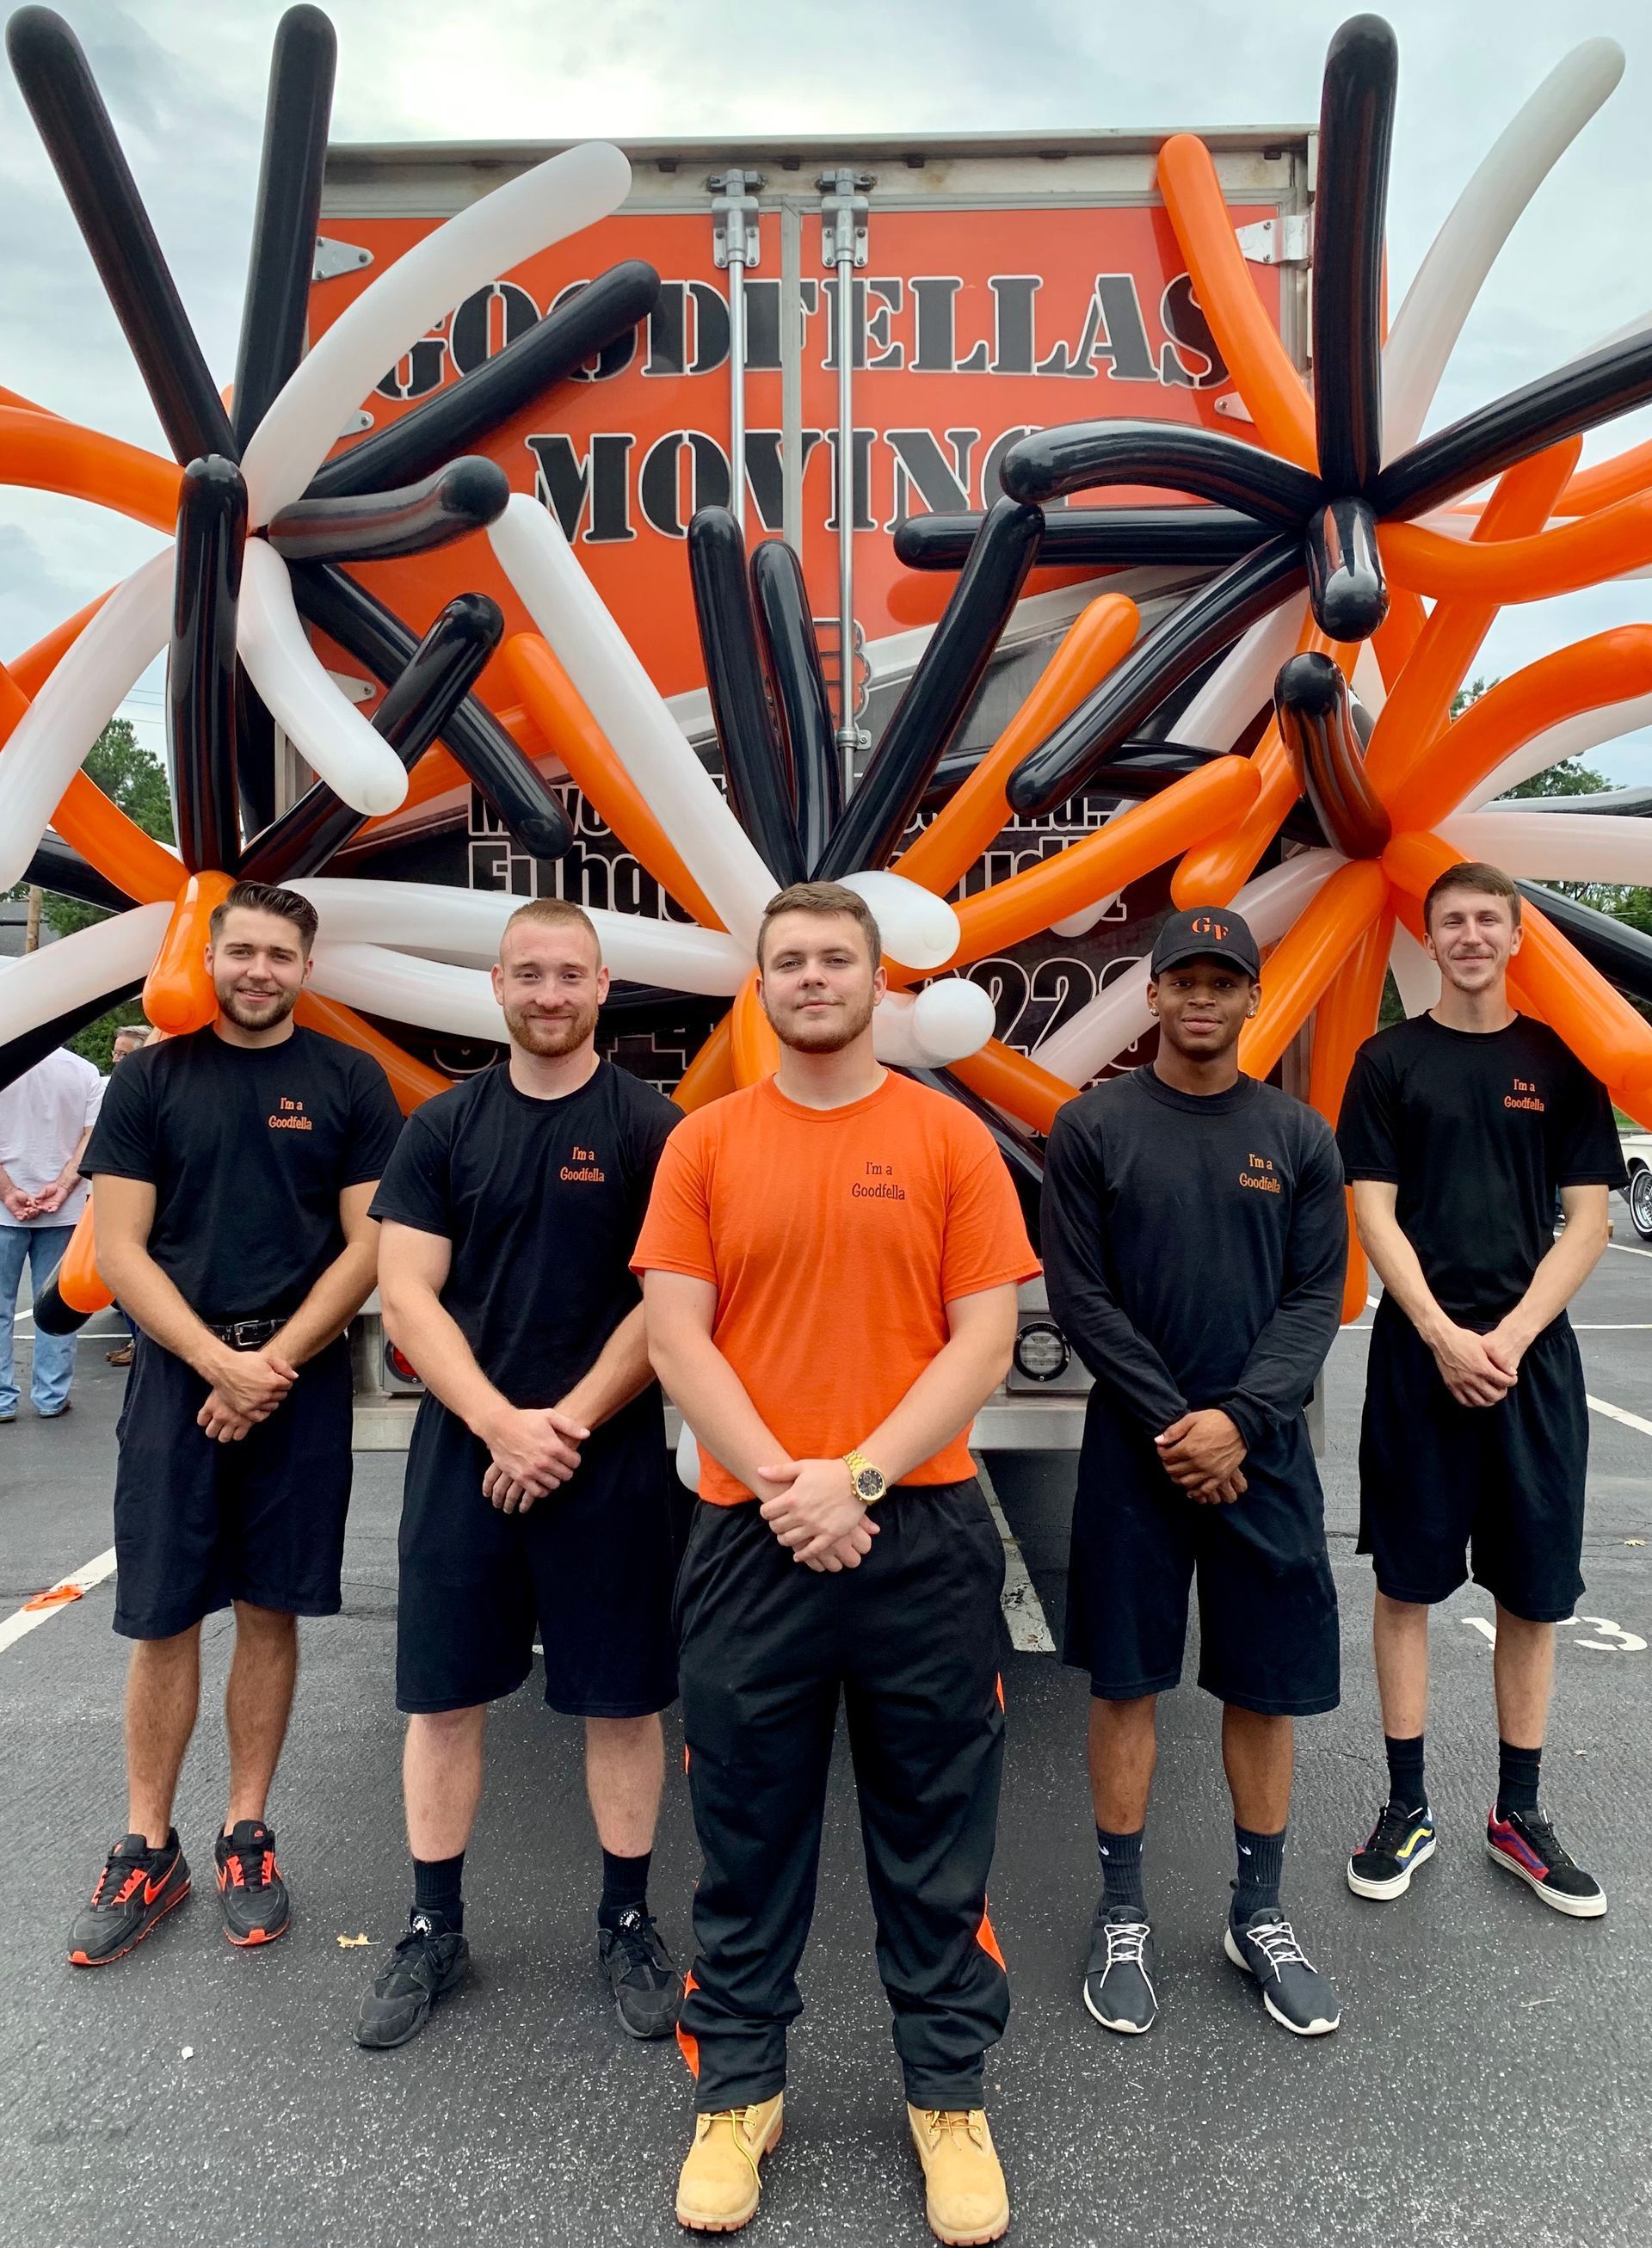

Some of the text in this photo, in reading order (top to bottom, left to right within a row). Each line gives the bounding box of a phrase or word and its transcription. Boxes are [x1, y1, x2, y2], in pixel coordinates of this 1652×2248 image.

[1192, 916, 1230, 940] GF
[1513, 1078, 1536, 1093] I'm a
[280, 1097, 304, 1111] I'm a
[1504, 1095, 1544, 1112] Goodfella
[268, 1115, 312, 1130] Goodfella
[572, 1146, 595, 1161] I'm a
[866, 1161, 893, 1176] I'm a
[1248, 1154, 1273, 1171] I'm a
[559, 1166, 605, 1183] Goodfella
[1239, 1172, 1281, 1194] Goodfella
[852, 1182, 906, 1201] Goodfella
